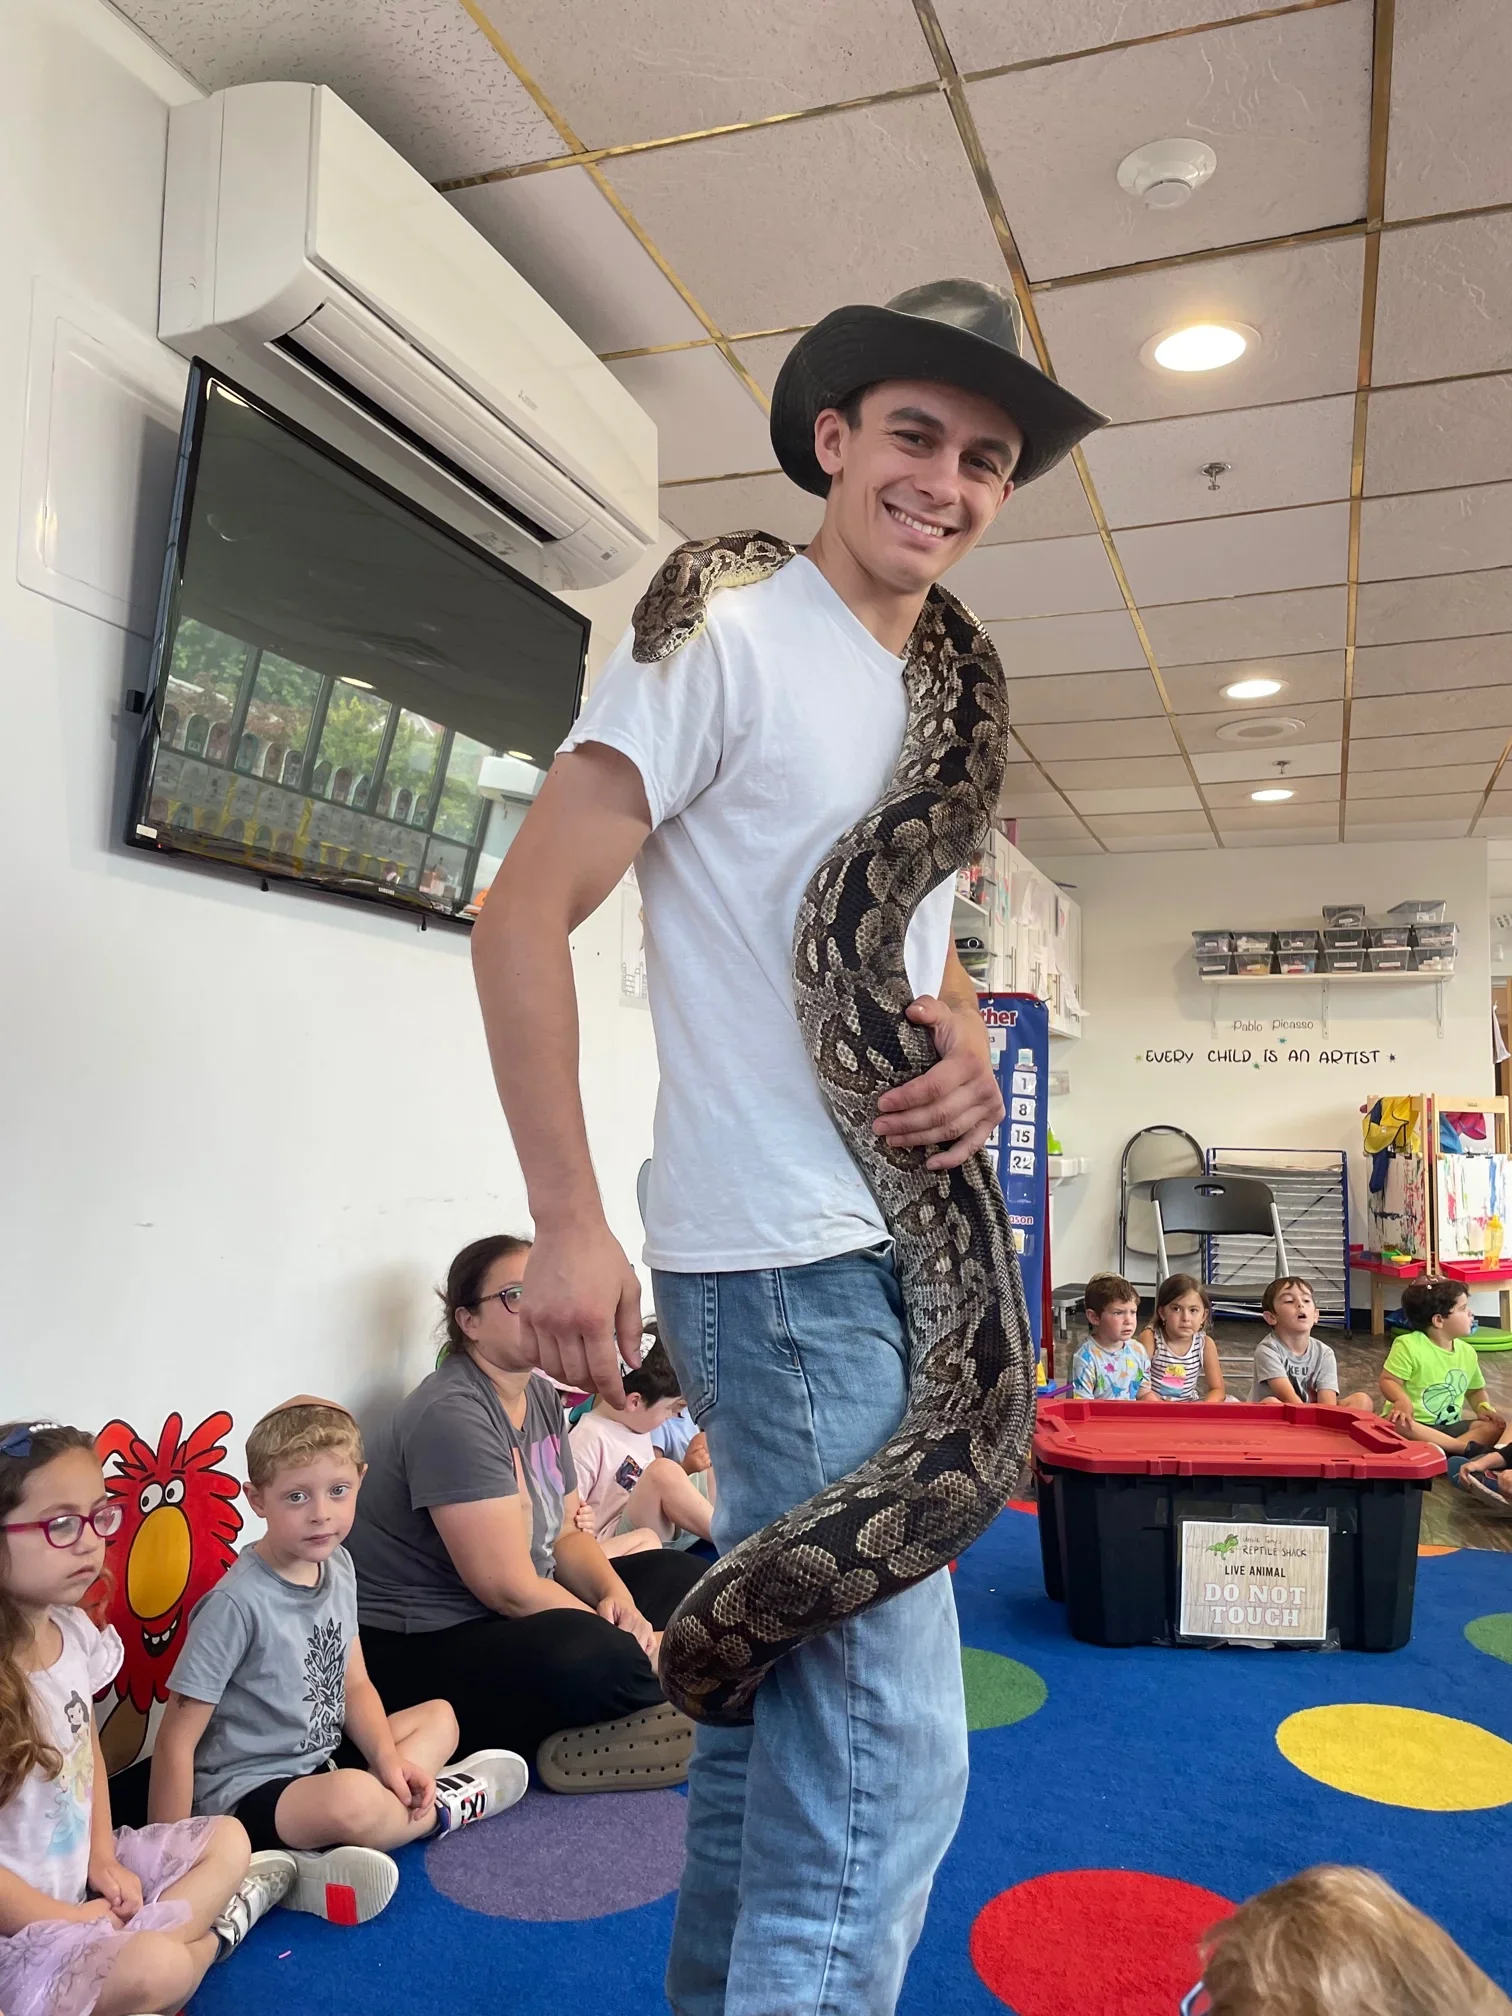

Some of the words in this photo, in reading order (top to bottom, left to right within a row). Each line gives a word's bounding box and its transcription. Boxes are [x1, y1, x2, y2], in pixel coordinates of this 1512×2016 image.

[980, 1007, 1018, 1027] ther
[1233, 1020, 1263, 1032] Pablo
[1272, 1019, 1314, 1031] Picasso
[1145, 1049, 1194, 1064] EVERY
[1207, 1049, 1252, 1063] CHILD
[1263, 1049, 1278, 1063] IS
[1288, 1049, 1310, 1063] AN
[1319, 1050, 1381, 1065] ARTIST
[1021, 1077, 1027, 1090] 1
[1018, 1103, 1028, 1117] 8
[1015, 1129, 1030, 1144] 15
[1012, 1155, 1032, 1170] 22
[1009, 1215, 1034, 1225] ason
[1242, 1545, 1278, 1557] REPTILE
[1281, 1547, 1307, 1558] SHACK
[1224, 1565, 1246, 1576] LIVE
[1249, 1565, 1286, 1578] ANIMAL
[1204, 1583, 1240, 1602] DO
[1248, 1584, 1306, 1605] NOT
[1210, 1606, 1300, 1627] TOUCH
